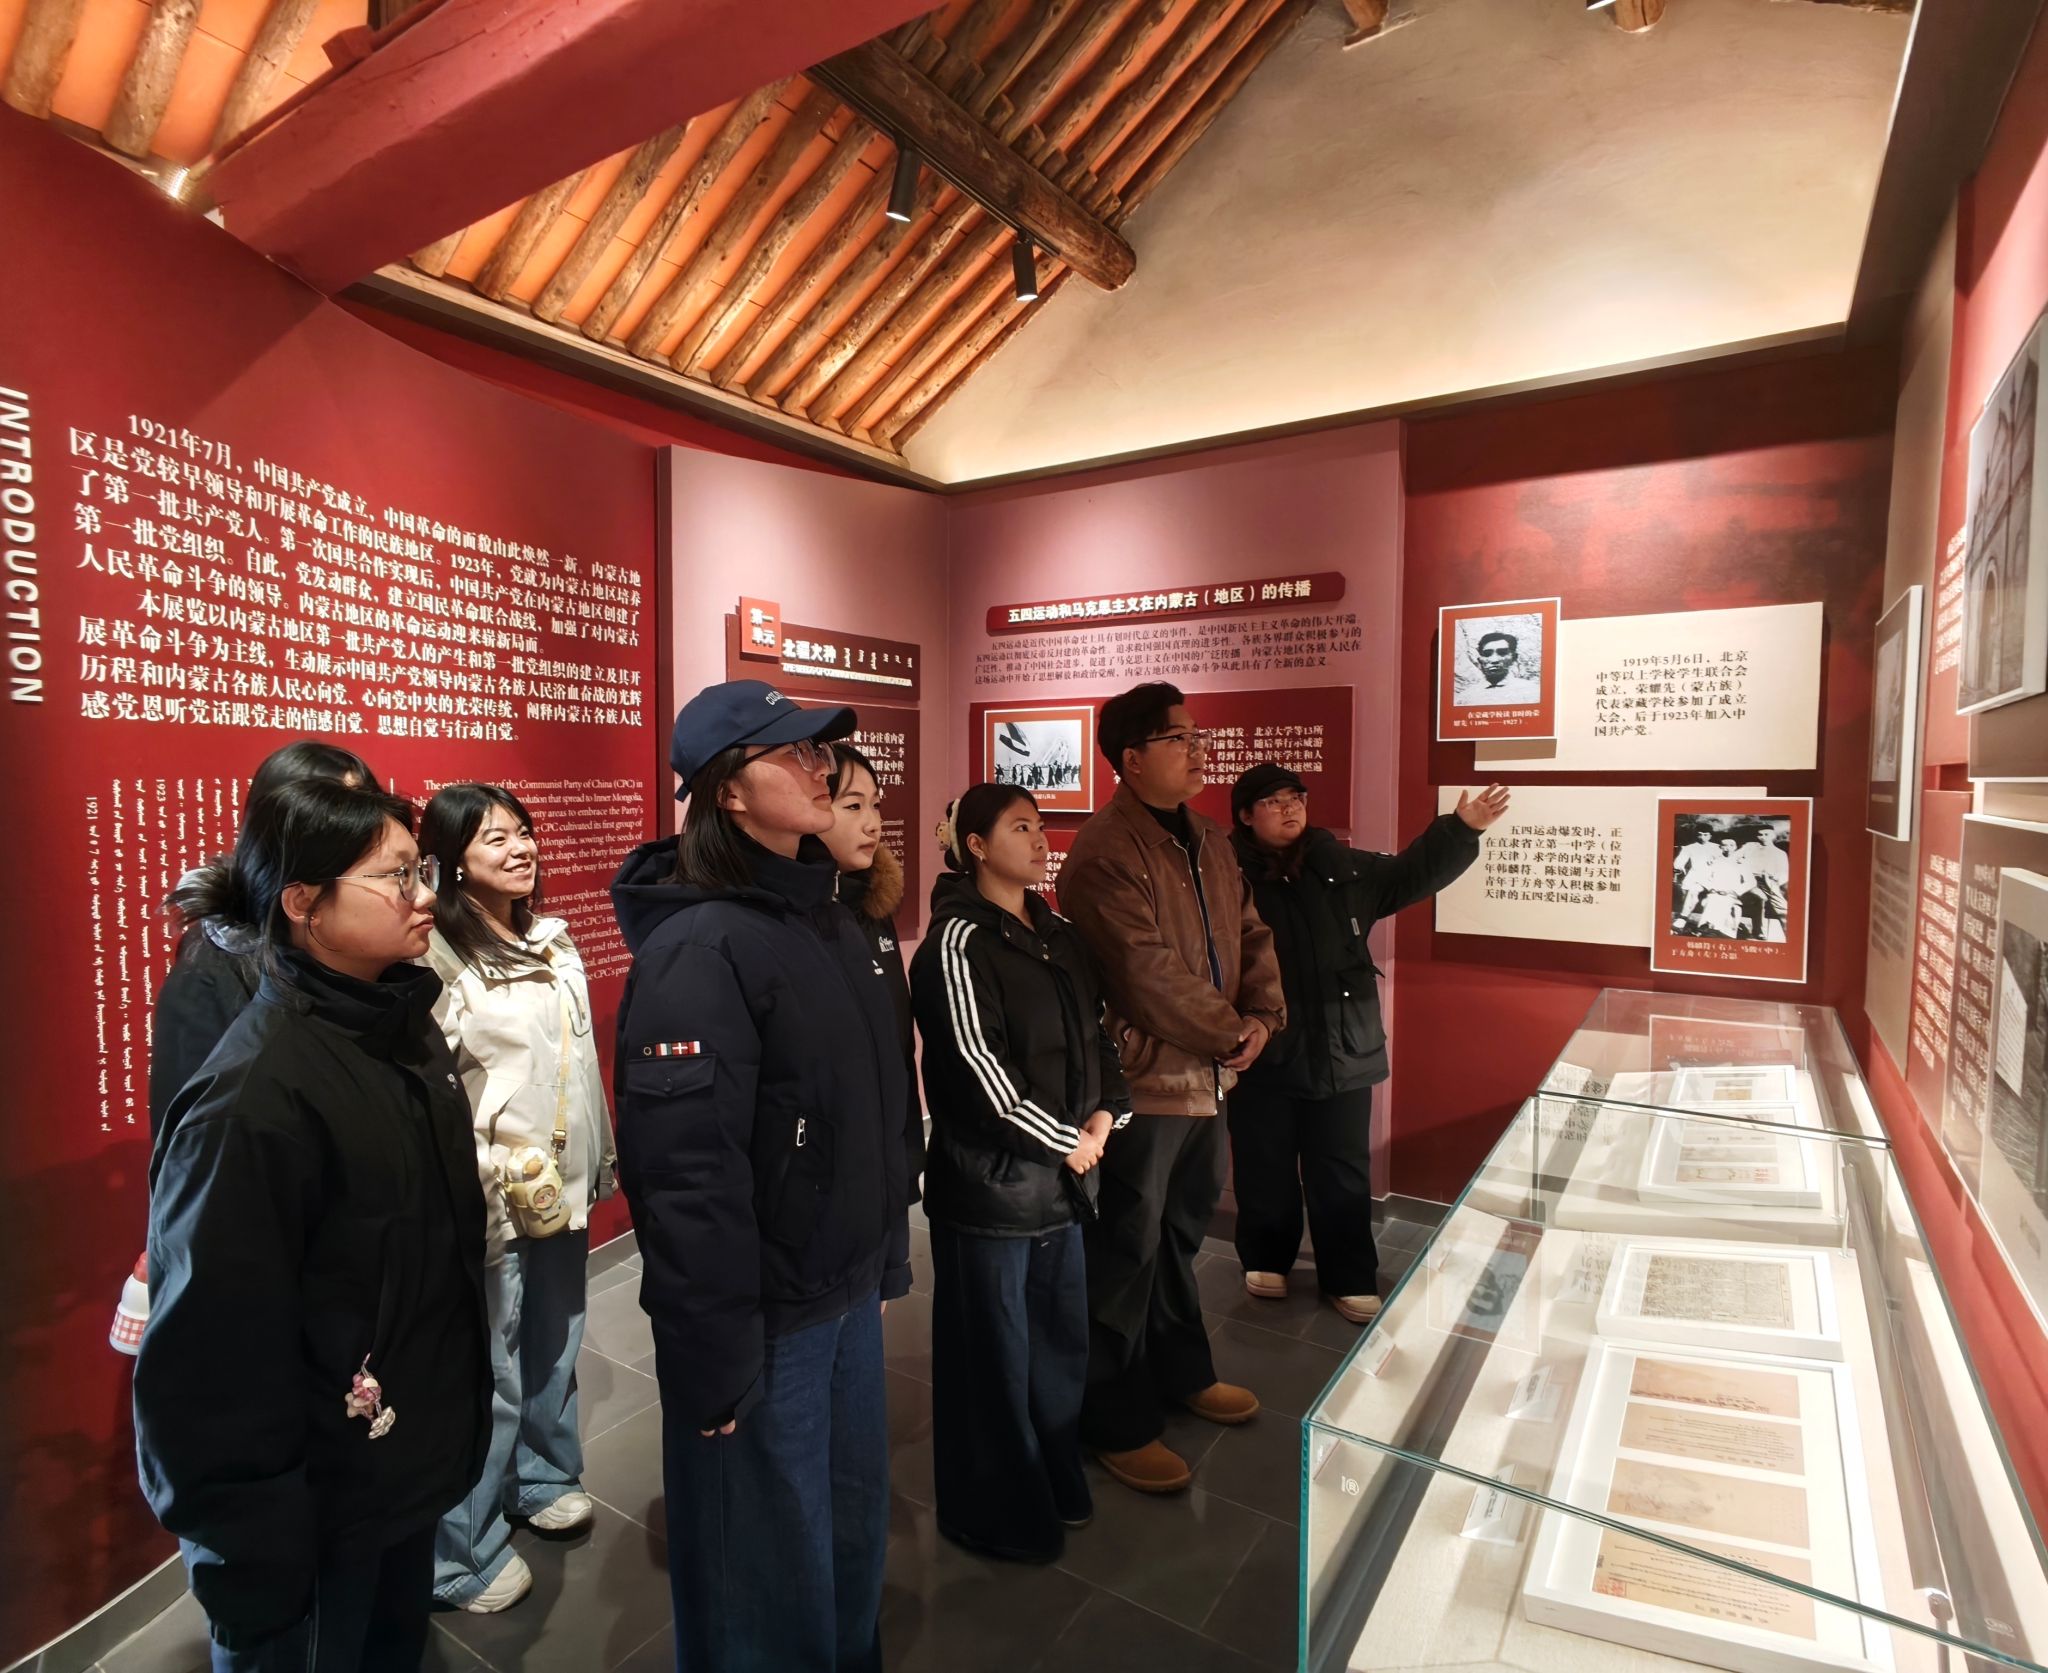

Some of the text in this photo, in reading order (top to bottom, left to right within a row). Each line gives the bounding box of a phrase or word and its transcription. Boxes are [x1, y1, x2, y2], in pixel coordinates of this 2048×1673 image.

[0, 386, 44, 703] INTRODUCTION
[1008, 579, 1312, 623] 五四运动和马克思主义在内蒙古（地区）的传播
[1623, 650, 1748, 667] 1919年5月6日，北京
[1596, 665, 1748, 682] 中等以上学校学生联合会
[1596, 694, 1747, 710] 代表蒙藏学校参加了成立
[520, 780, 562, 788] Communist
[564, 780, 582, 791] Party
[592, 779, 612, 788] China
[548, 794, 562, 803] that
[562, 794, 584, 805] spread
[578, 806, 608, 816] embrace
[609, 806, 620, 815] the
[540, 822, 558, 832] CPC
[560, 821, 592, 832] cultivated
[1510, 826, 1622, 838] 五四运动爆发时，正
[606, 834, 616, 842] the
[578, 850, 590, 858] the
[591, 848, 607, 858] Party
[548, 864, 571, 878] paving
[572, 864, 584, 872] the
[584, 863, 597, 873] way
[598, 861, 608, 869] for
[1485, 876, 1620, 892] 青年于方舟等人积极参加
[559, 894, 573, 904] you
[573, 890, 599, 902] explore
[568, 904, 582, 915] and
[594, 902, 614, 911] forma
